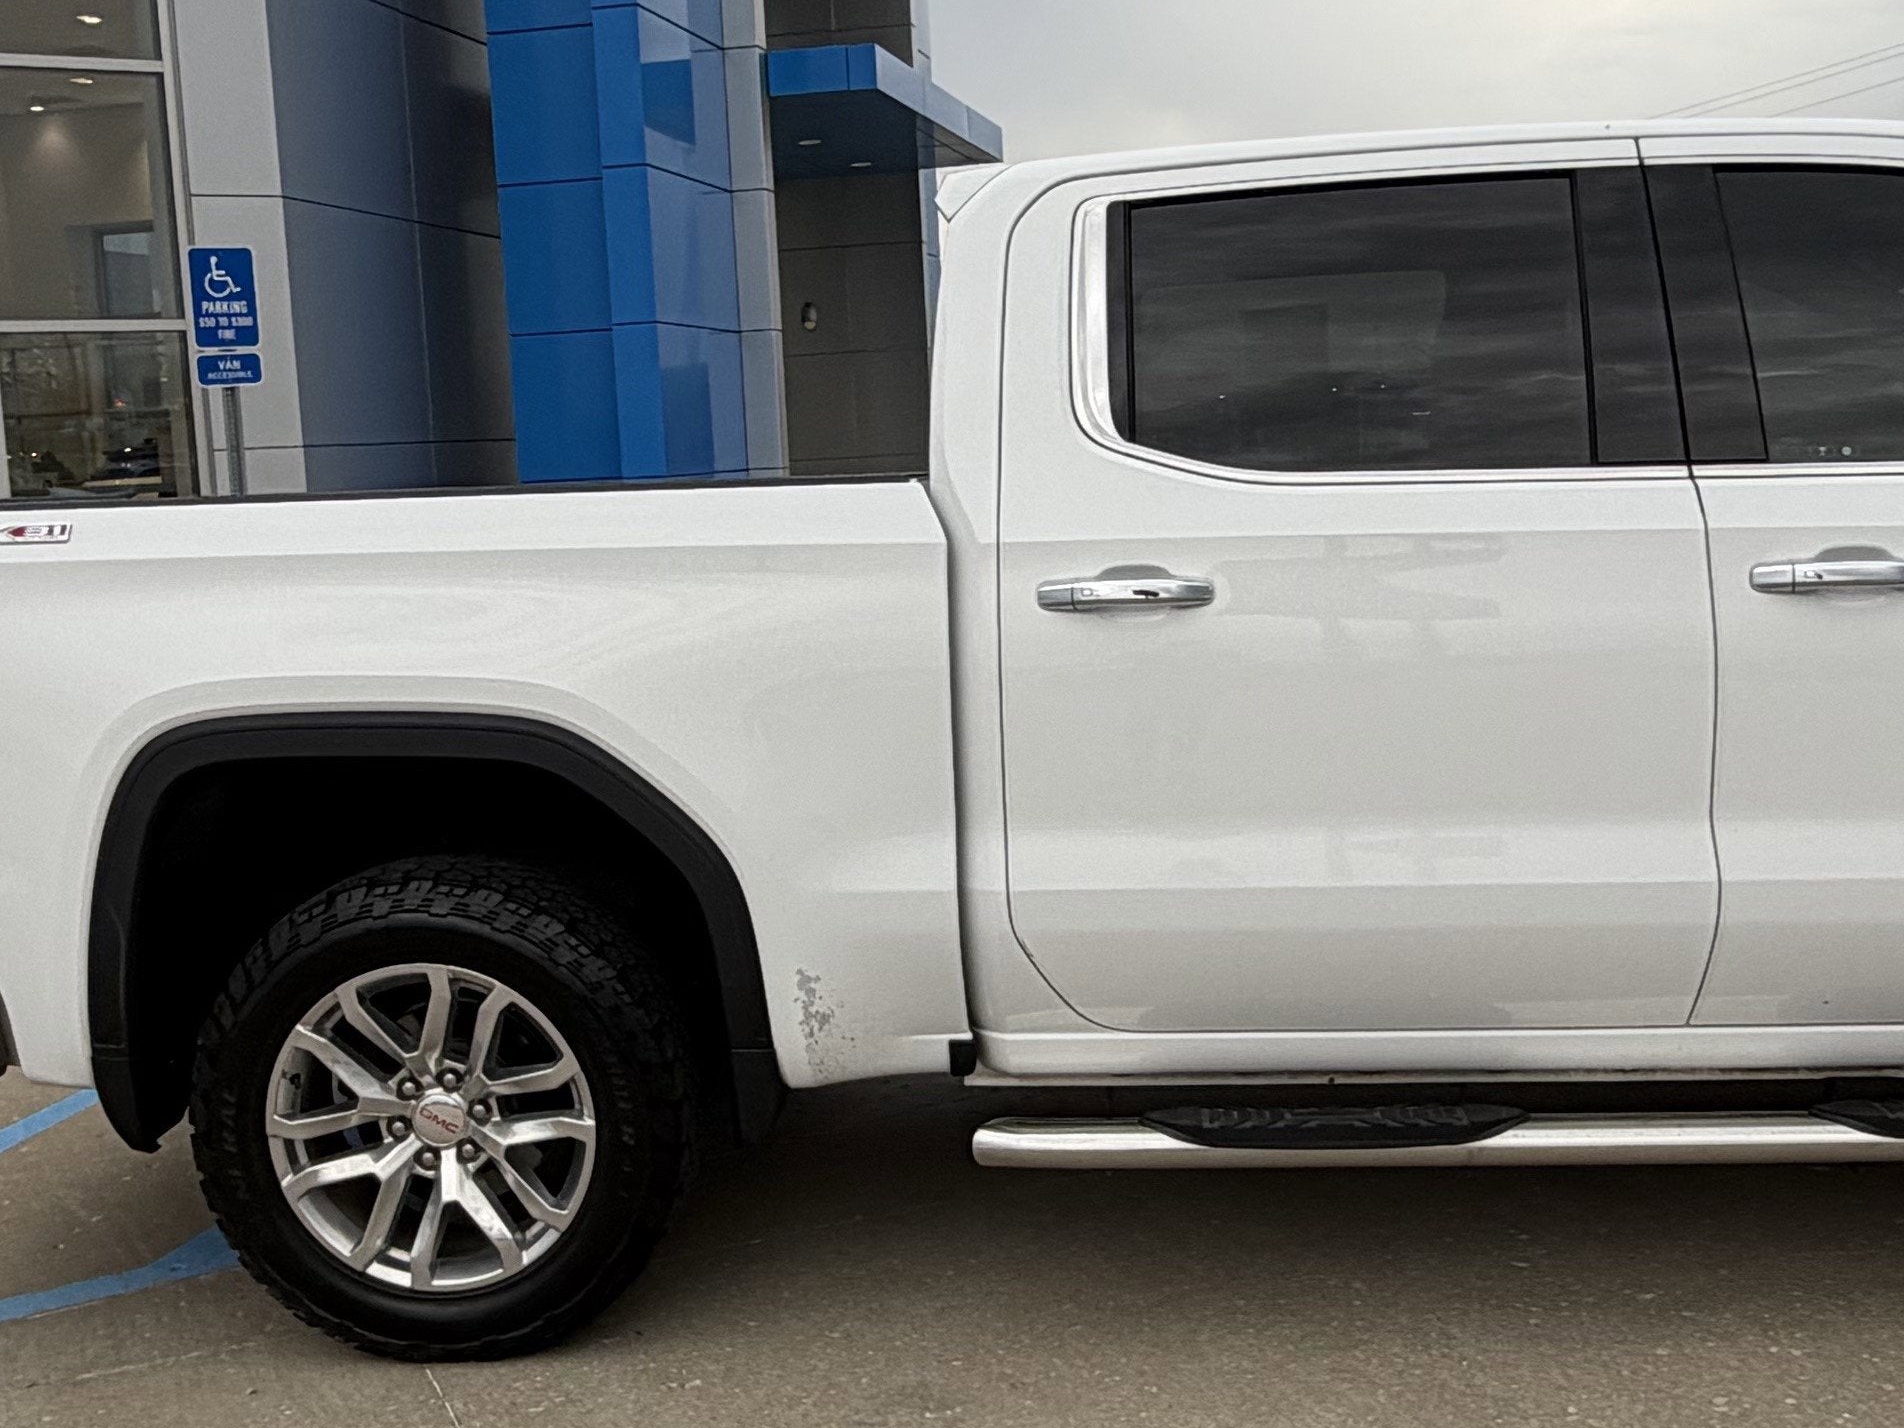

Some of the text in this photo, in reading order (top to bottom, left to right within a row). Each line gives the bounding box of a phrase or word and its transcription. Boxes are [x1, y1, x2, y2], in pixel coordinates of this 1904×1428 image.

[201, 301, 248, 314] PARKING
[218, 359, 241, 371] VAN
[419, 1107, 459, 1135] GMC
